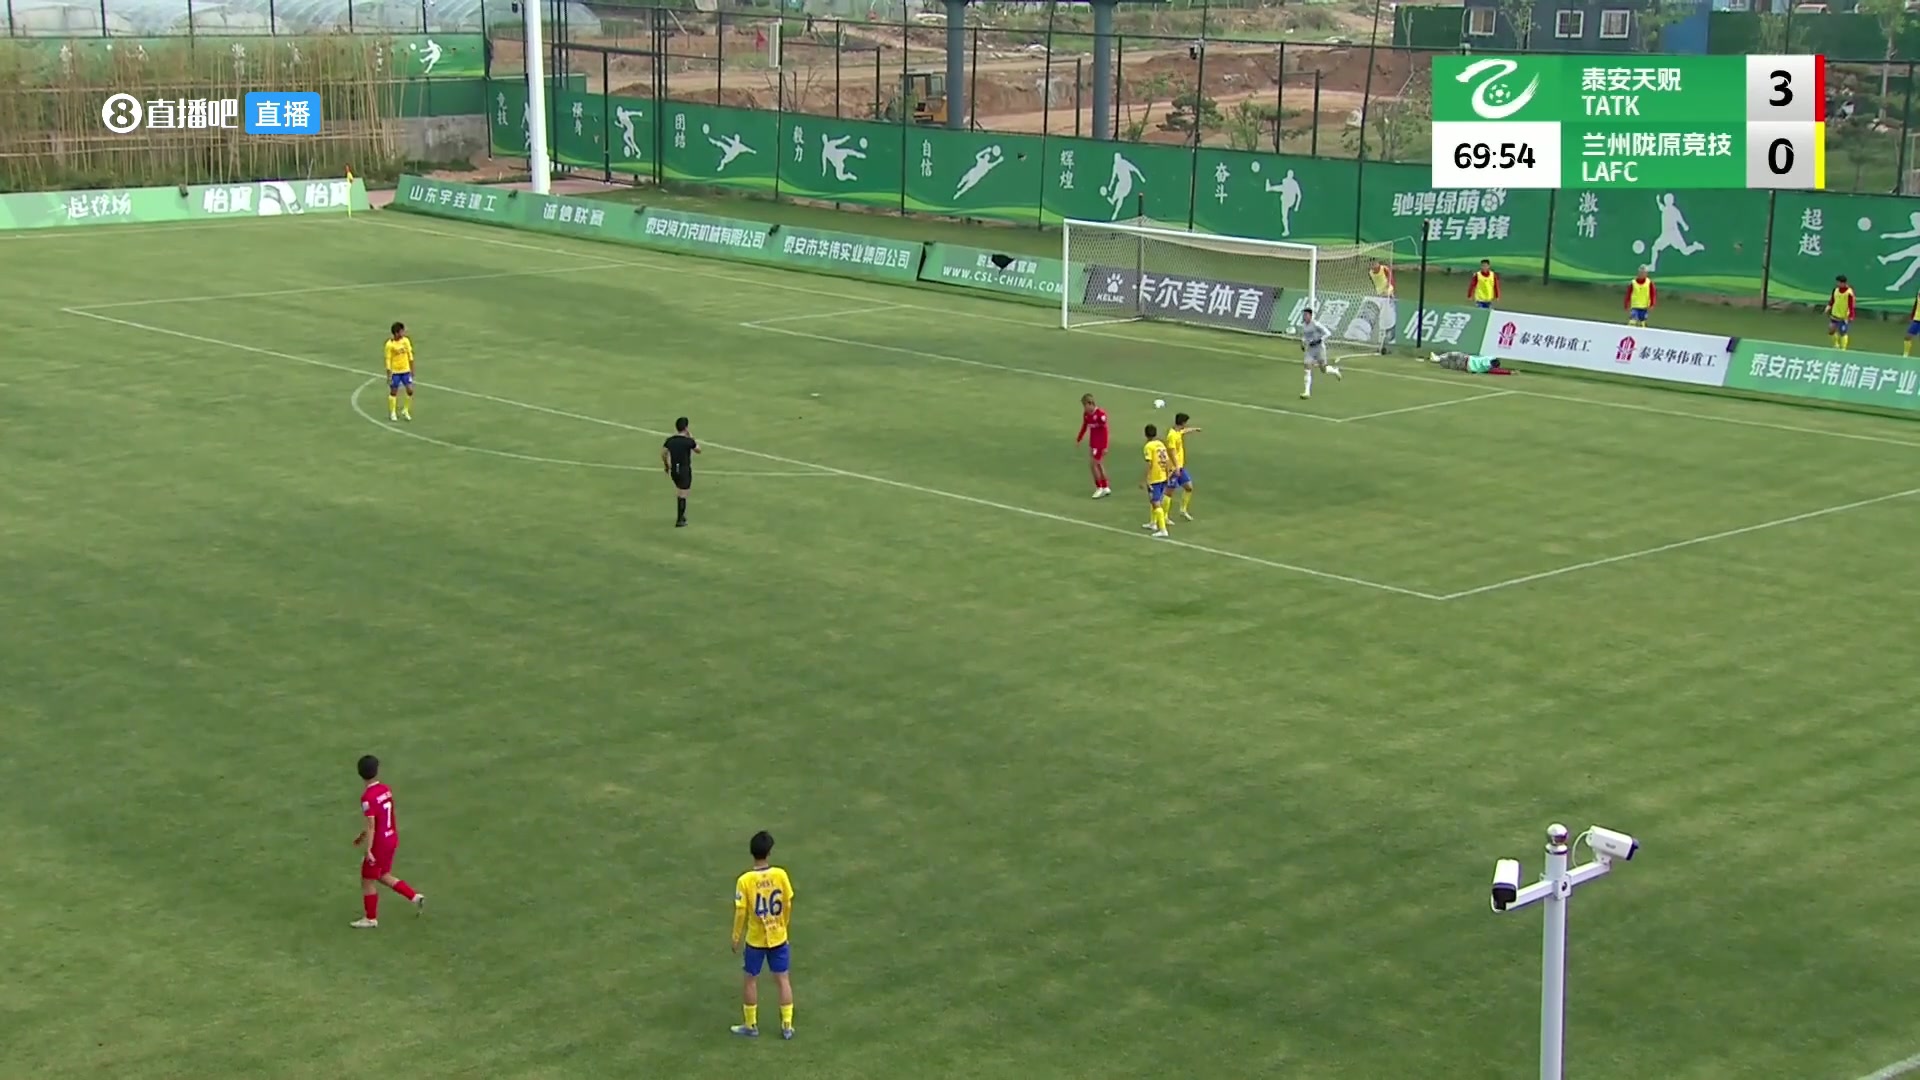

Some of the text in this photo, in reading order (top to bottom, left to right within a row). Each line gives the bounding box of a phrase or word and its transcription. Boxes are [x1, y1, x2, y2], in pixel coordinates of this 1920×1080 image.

[674, 113, 686, 149] 团结
[793, 125, 804, 162] 毅力
[921, 139, 933, 177] 自信
[1059, 150, 1075, 189] 辉煌
[1214, 162, 1230, 204] 奋斗
[1577, 190, 1598, 238] 激情
[1798, 207, 1823, 256] 超越
[783, 235, 911, 269] 泰安市华伟实业集团公司
[942, 266, 1064, 293] WWW.CSL-CHINA.COM
[1132, 274, 1264, 320] 卡尔美体育
[1519, 331, 1592, 352] 泰安华伟重工
[1639, 346, 1718, 367] 泰安华伟重工
[1749, 353, 1920, 395] 泰安市华伟体育产业
[383, 801, 392, 828] 7
[755, 888, 783, 918] 46
